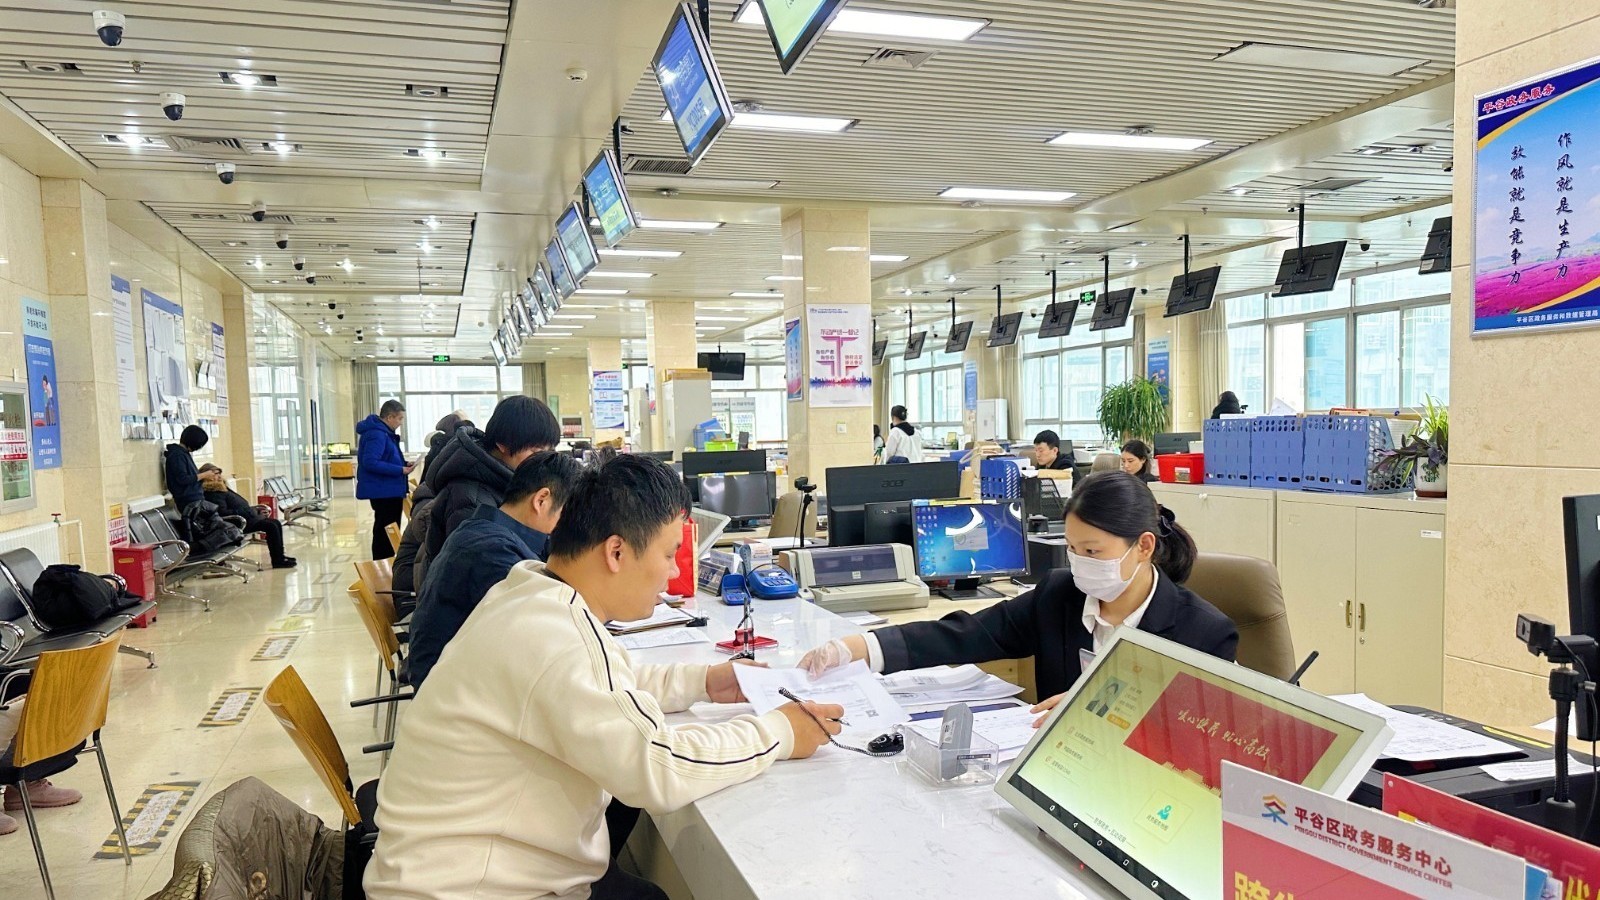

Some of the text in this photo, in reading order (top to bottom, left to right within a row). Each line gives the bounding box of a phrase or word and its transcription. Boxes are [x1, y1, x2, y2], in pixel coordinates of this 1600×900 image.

[1482, 83, 1555, 113] 平谷政务服务
[1555, 132, 1574, 280] 作风就是生产力
[1516, 309, 1599, 323] 平谷区政务服务和数据管理局
[881, 478, 906, 488] acer
[1294, 806, 1452, 876] 平谷区政务服务中心
[1318, 832, 1346, 849] DISTRICT
[1346, 844, 1393, 866] GOVERNMENT
[1393, 861, 1423, 878] SERVICE
[1423, 871, 1453, 889] CENTER
